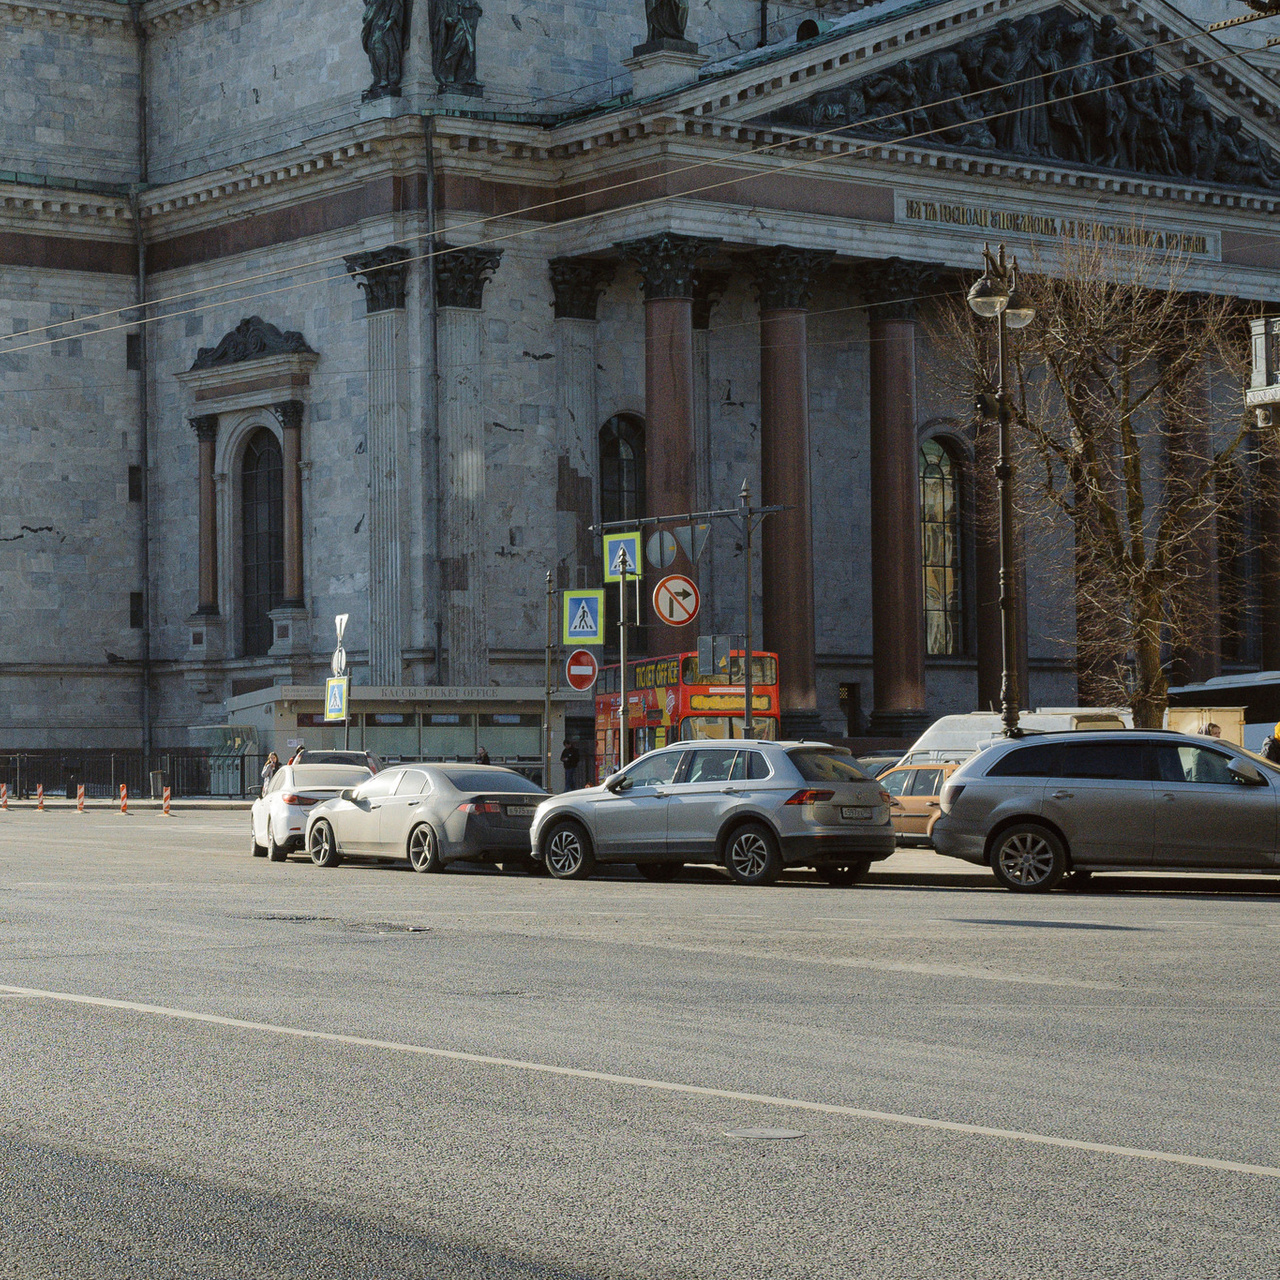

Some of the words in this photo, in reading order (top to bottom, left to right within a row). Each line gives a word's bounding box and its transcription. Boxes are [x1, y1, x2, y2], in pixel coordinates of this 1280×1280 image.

[636, 664, 655, 689] TICKET
[655, 660, 678, 686] OFFICE
[381, 686, 417, 698] КАССЫ
[423, 687, 460, 698] TICKET
[462, 687, 499, 699] OFFICE
